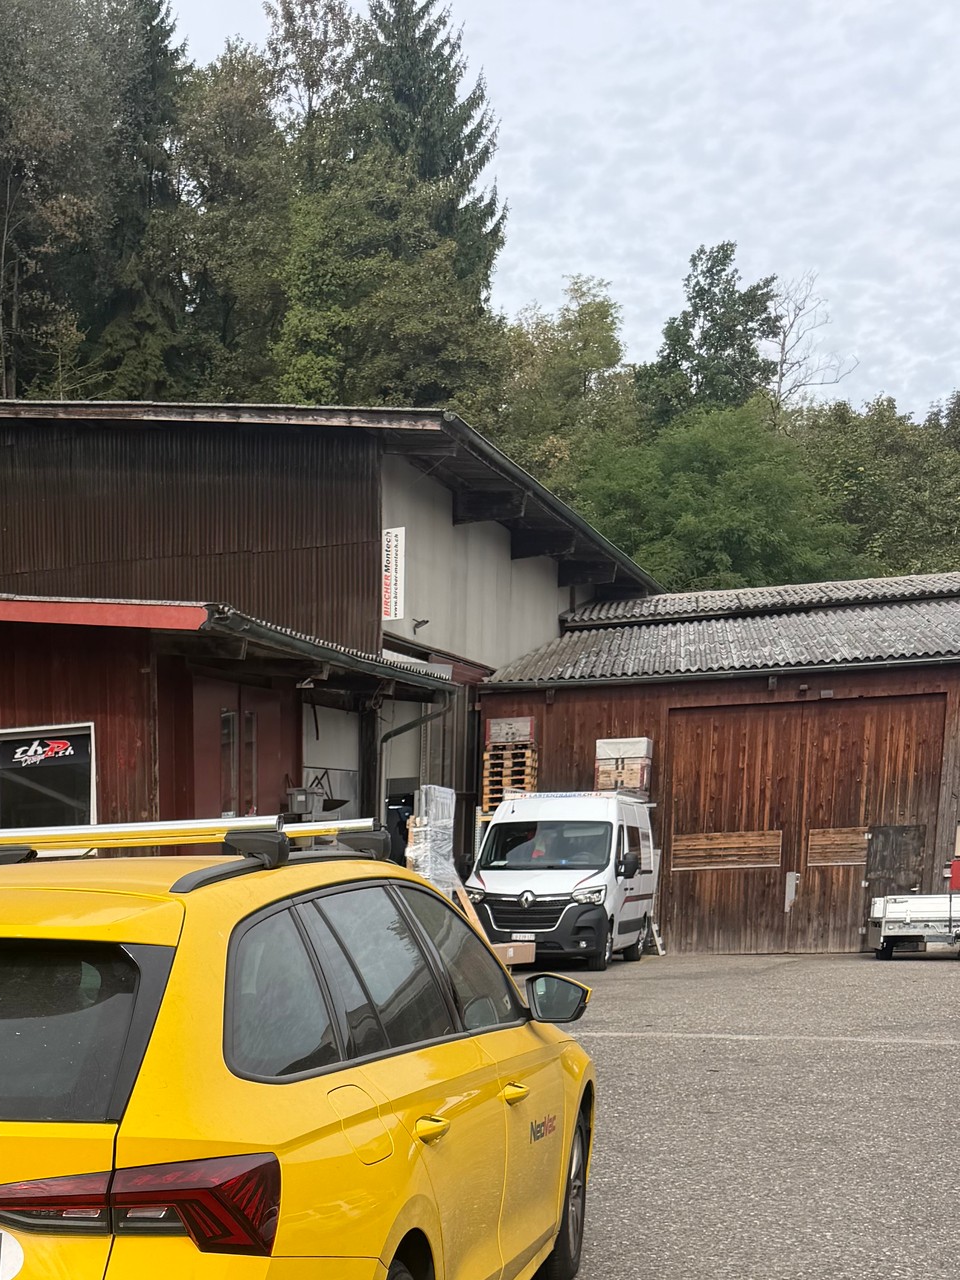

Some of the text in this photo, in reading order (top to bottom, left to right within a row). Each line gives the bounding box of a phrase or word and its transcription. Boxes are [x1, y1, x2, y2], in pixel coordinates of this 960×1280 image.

[383, 531, 392, 617] BIRCHER Montech
[529, 1114, 556, 1145] NeoVac
